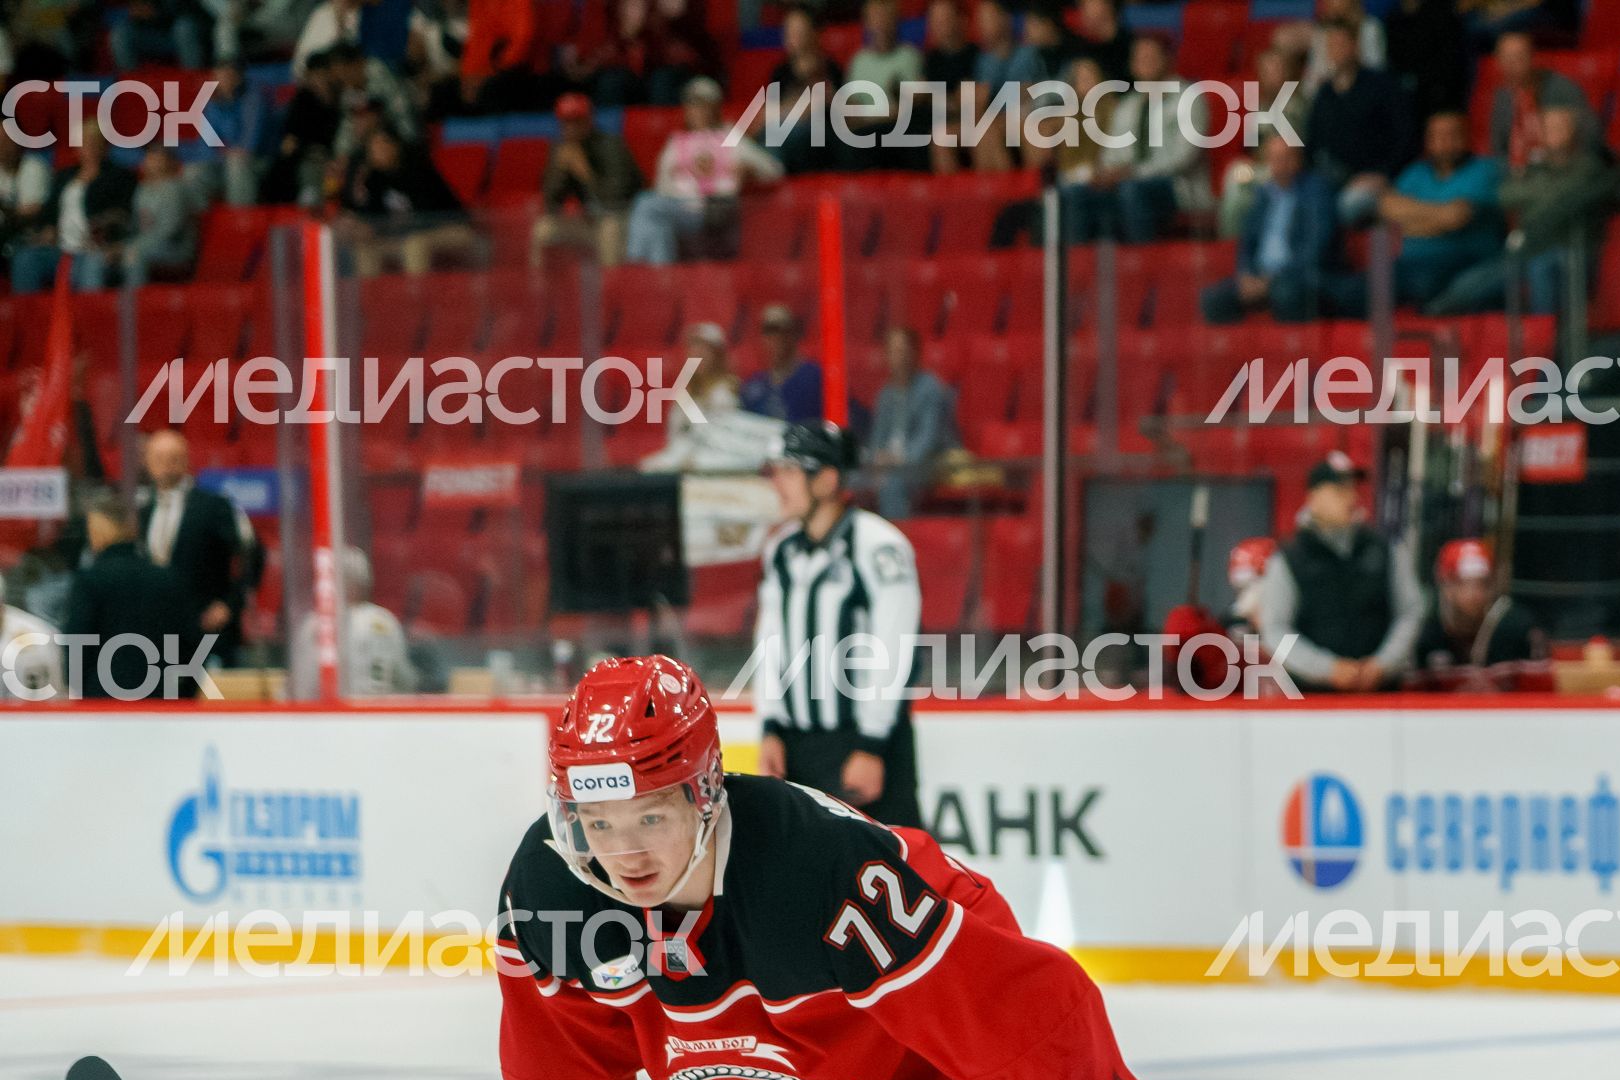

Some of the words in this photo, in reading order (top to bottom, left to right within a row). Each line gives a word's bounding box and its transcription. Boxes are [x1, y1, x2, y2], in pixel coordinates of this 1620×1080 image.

[584, 713, 616, 745] 72
[572, 775, 631, 791] согаз
[822, 860, 941, 976] 72
